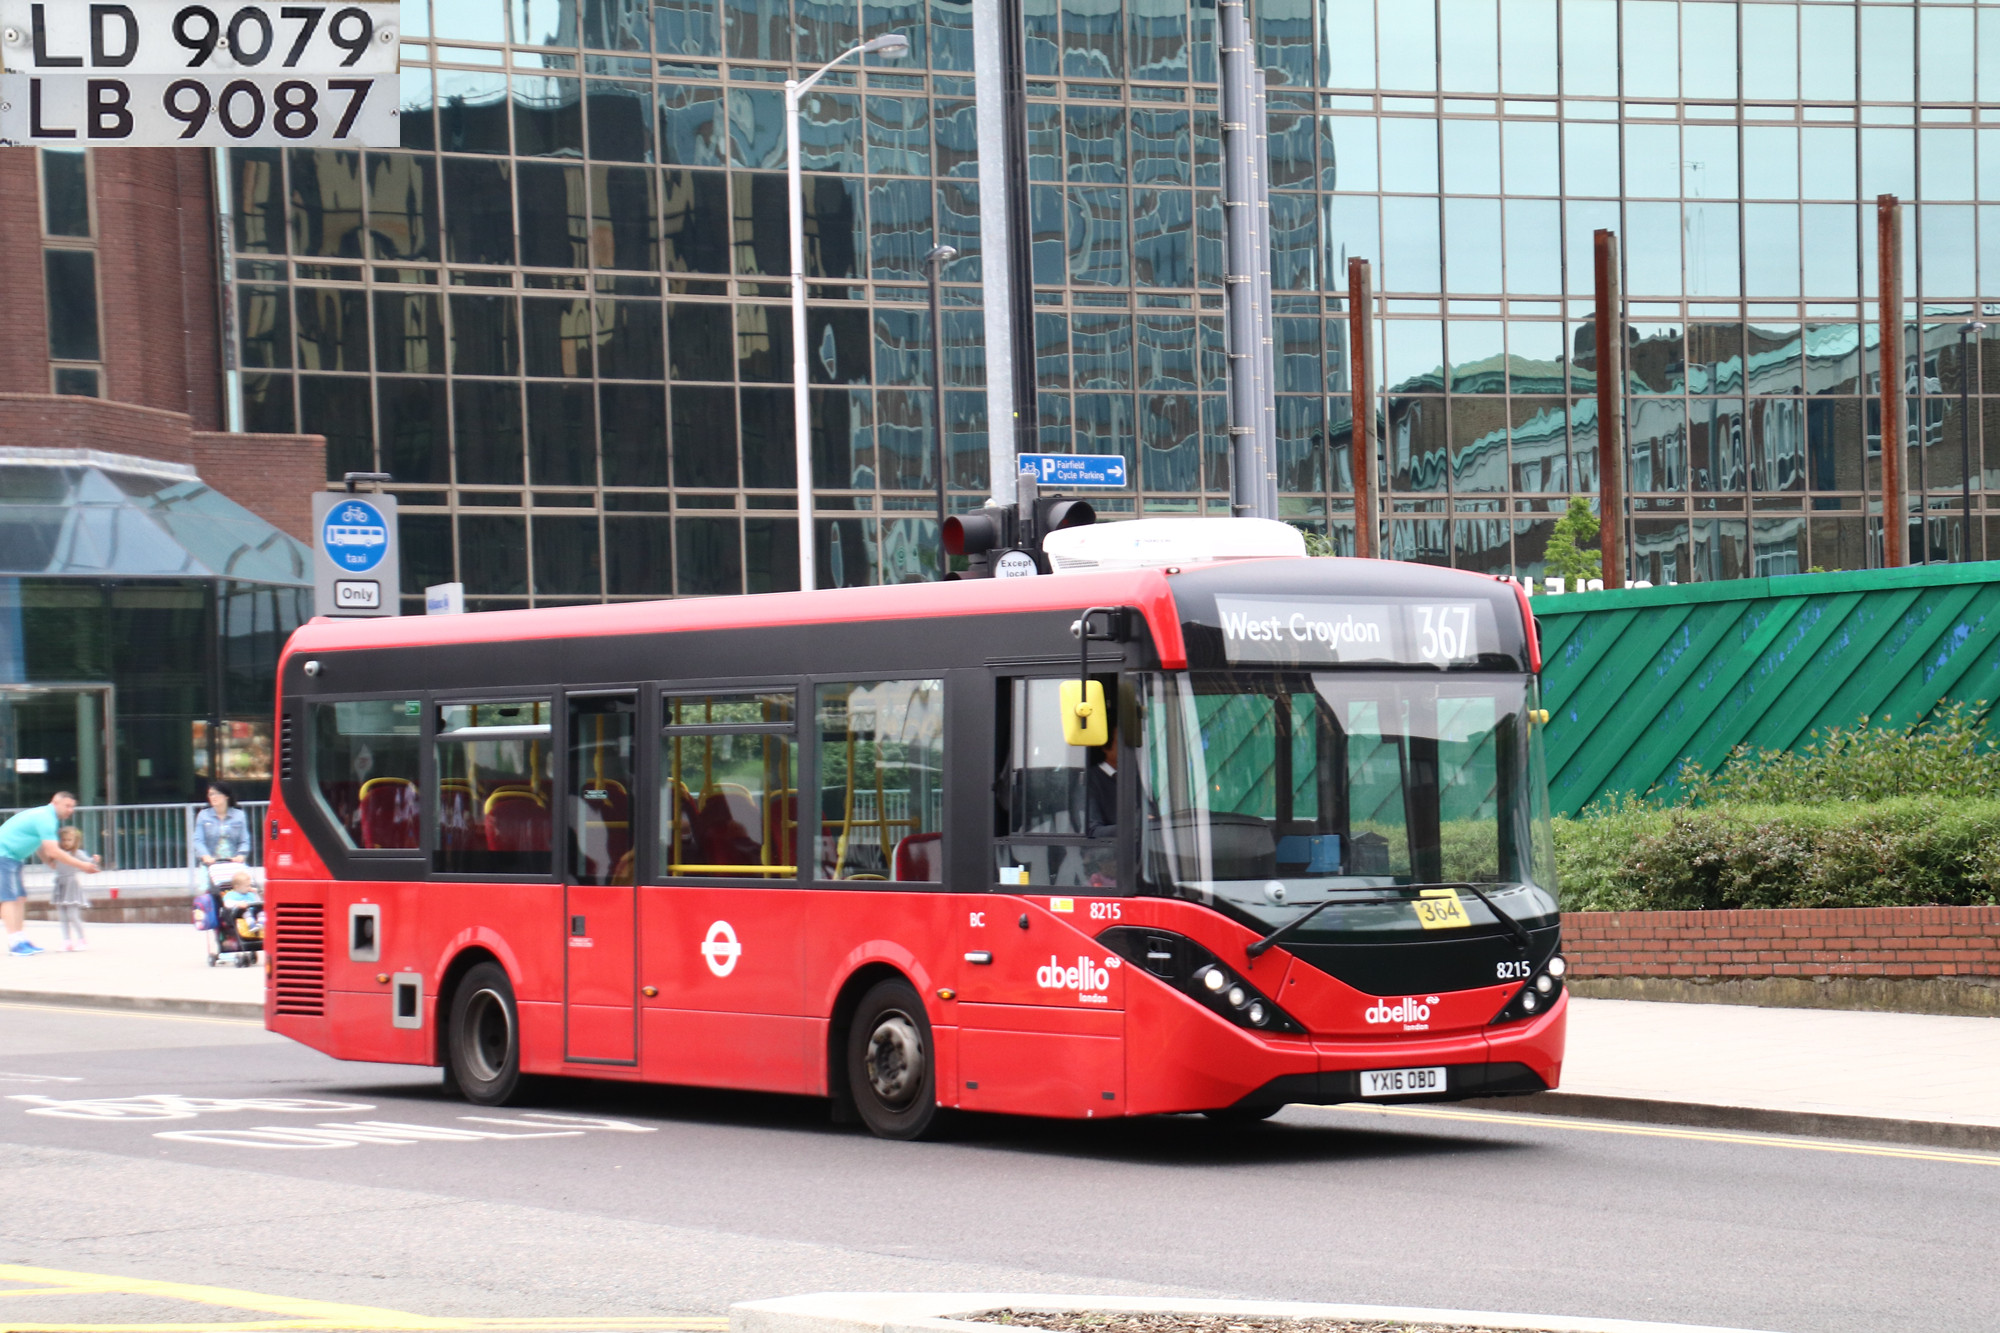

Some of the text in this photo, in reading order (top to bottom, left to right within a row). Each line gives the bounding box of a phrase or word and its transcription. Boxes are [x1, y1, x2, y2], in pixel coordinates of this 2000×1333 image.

[1057, 461, 1085, 469] Fairfield
[1058, 471, 1105, 480] Cycle Parking
[346, 554, 366, 563] taxi
[1001, 559, 1032, 568] Except
[1006, 569, 1028, 577] local
[342, 588, 373, 601] Only
[1221, 606, 1470, 659] West Croydon 367
[1090, 902, 1121, 919] 8215
[1420, 900, 1460, 922] 364
[970, 912, 985, 927] BC
[1036, 955, 1110, 991] abellio
[1496, 960, 1531, 979] 8215
[1079, 993, 1108, 1003] london
[1365, 997, 1430, 1024] abellio
[1403, 1023, 1429, 1031] london
[1370, 1070, 1436, 1091] YX16 OBD
[152, 1112, 659, 1150] ONLY
